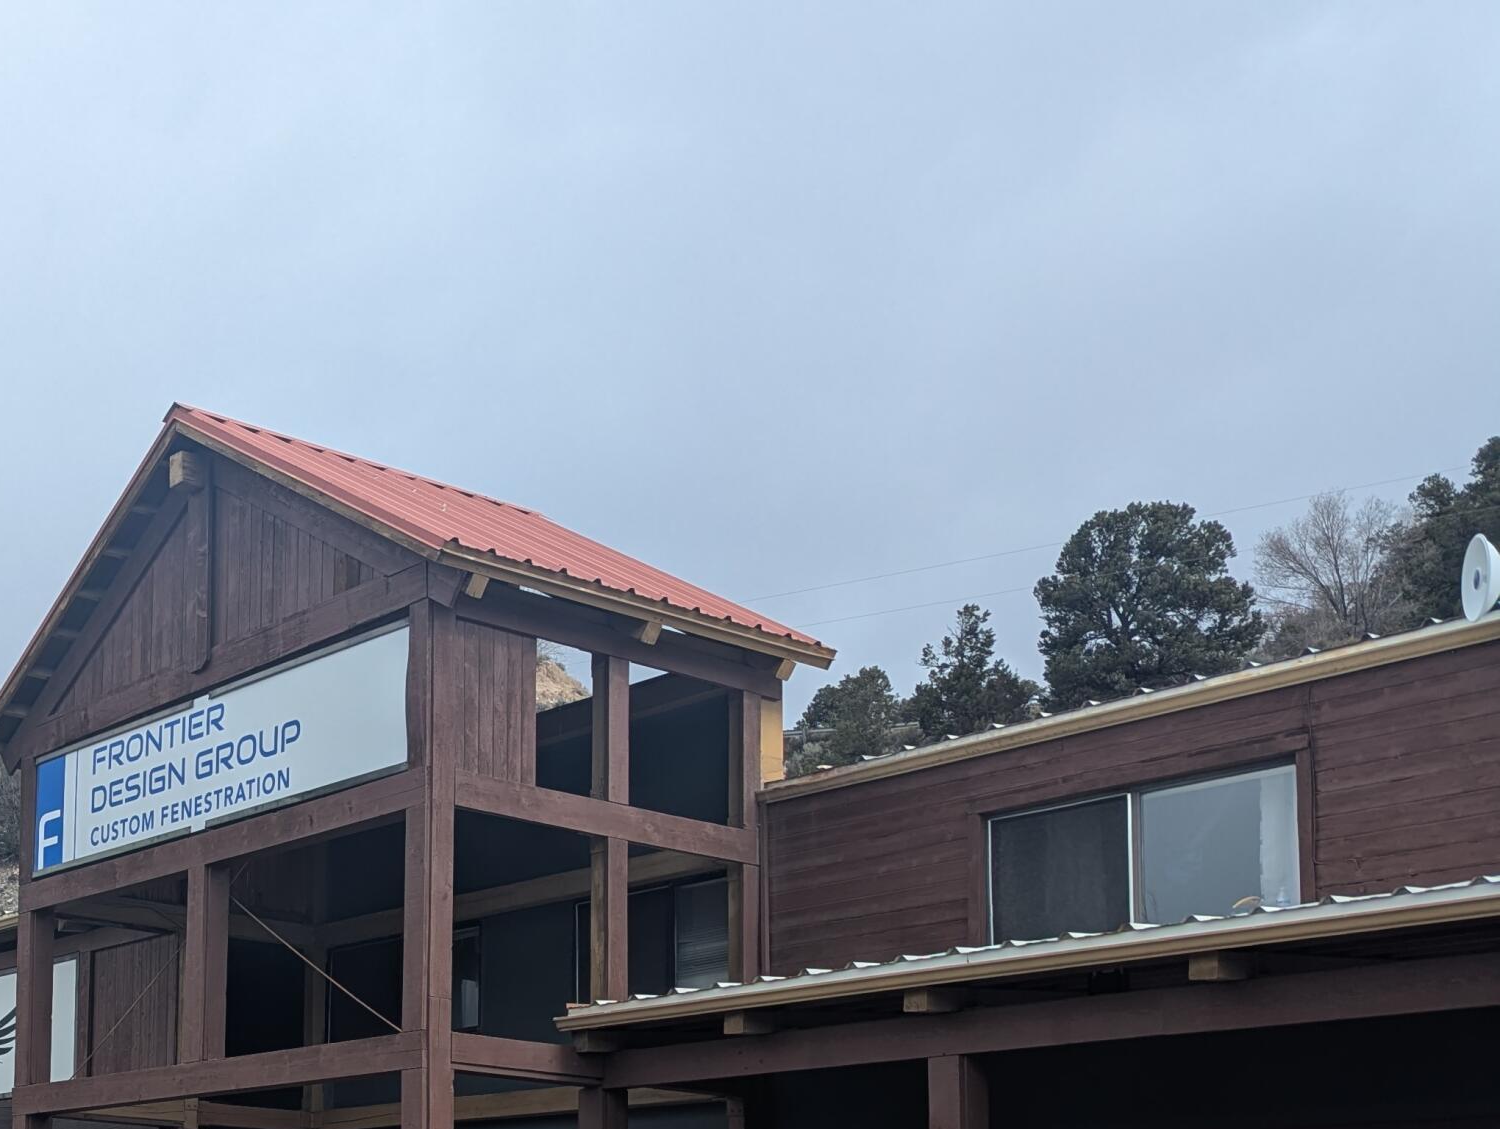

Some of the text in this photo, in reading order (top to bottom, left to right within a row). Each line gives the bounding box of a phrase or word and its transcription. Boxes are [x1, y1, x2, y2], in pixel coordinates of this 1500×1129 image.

[91, 719, 301, 814] DESIGN GROUP
[92, 703, 225, 775] FRONTIER
[37, 808, 61, 871] F
[90, 767, 291, 846] CUSTOM FENESTRATION
